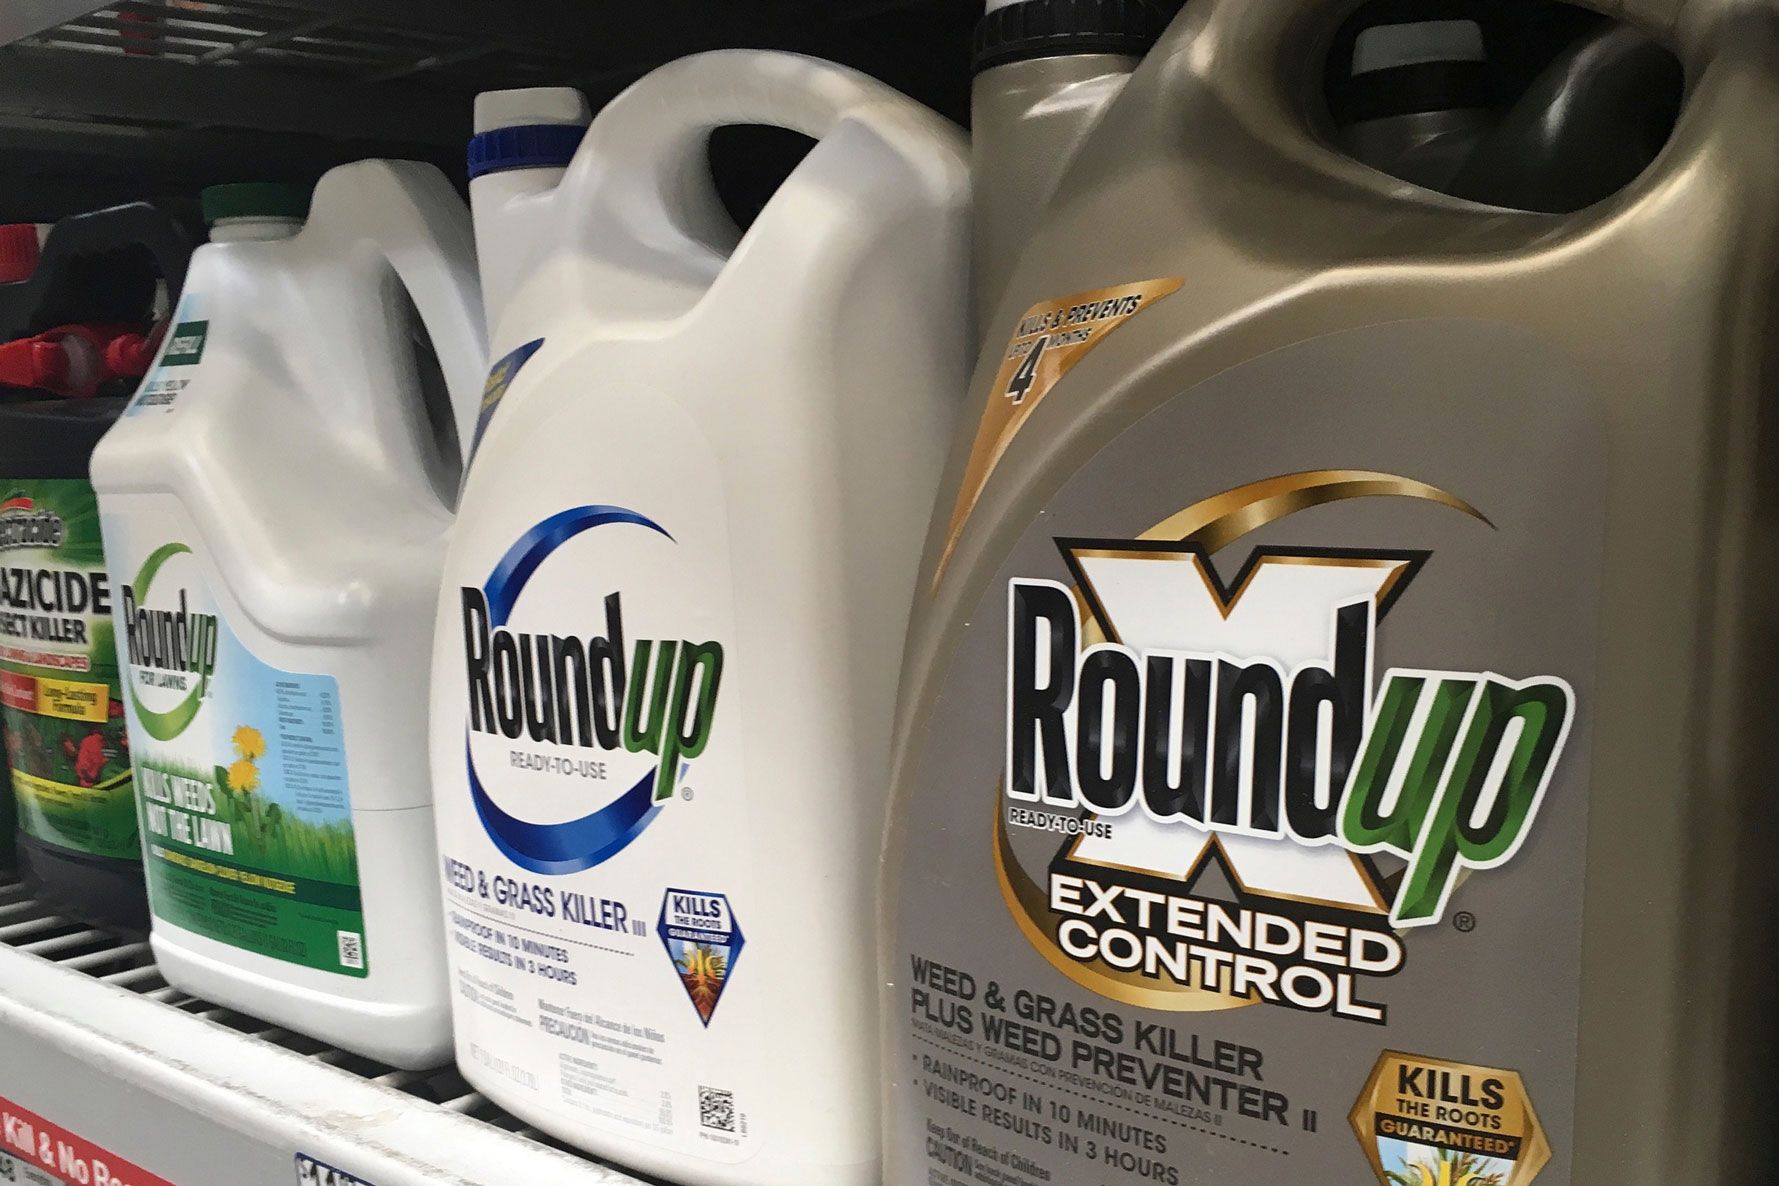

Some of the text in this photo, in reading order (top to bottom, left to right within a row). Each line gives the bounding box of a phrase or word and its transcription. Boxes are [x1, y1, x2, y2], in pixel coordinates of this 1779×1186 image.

[1066, 294, 1143, 325] PREVENTS
[1005, 335, 1050, 405] 4
[30, 615, 88, 644] KILLER
[121, 585, 218, 698] Roundup
[461, 586, 724, 801] Roundup
[509, 749, 608, 781] READY-TO-USE
[1008, 578, 1574, 926] Roundup
[1008, 807, 1114, 841] READY-TO-USE
[477, 869, 490, 900] &
[493, 875, 555, 918] GRASS
[560, 891, 629, 934] KILLER
[673, 894, 722, 918] KILLS
[674, 914, 722, 930] THE ROOTS
[1050, 872, 1403, 973] EXTENDED
[521, 938, 570, 964] MINUTES
[528, 959, 536, 975] 3
[537, 962, 578, 986] HOURS
[1057, 919, 1384, 1021] CONTROL
[911, 954, 1264, 1082] WEED & GRASS KILLER
[911, 987, 1319, 1134] PLUS WEED PREVENTER II
[1030, 1060, 1057, 1080] CON
[1135, 1091, 1152, 1109] DE
[1153, 1097, 1213, 1125] MALEZAS
[1397, 1063, 1505, 1111] KILLS
[922, 1054, 1168, 1155] RAINPROOF IN 10 MINUTES
[922, 1078, 1180, 1186] VISIBLE RESULTS IN 3 HOURS
[1396, 1097, 1503, 1130] THE ROOTS
[38, 1131, 57, 1169] &
[57, 1140, 90, 1186] No
